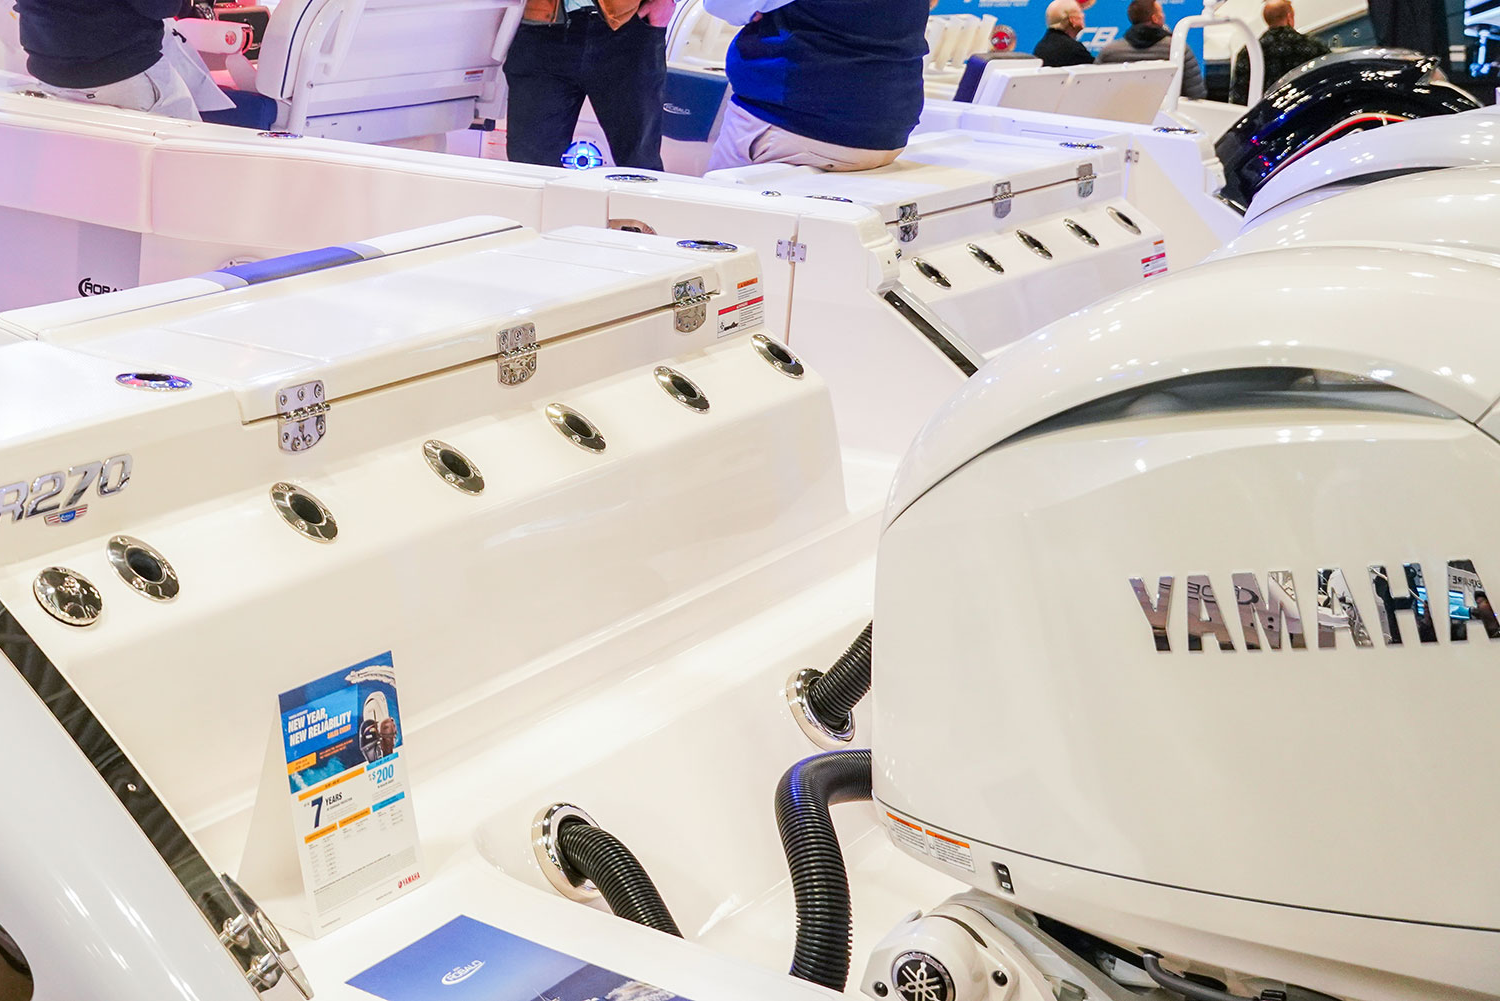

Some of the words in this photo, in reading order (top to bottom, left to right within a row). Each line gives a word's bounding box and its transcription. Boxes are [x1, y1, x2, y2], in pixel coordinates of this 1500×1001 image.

[1127, 559, 1500, 653] YAMAHA
[288, 713, 305, 734] NEW
[306, 707, 328, 726] YEAR,
[289, 731, 308, 748] NEW
[308, 710, 352, 740] RELIABILITY
[311, 795, 323, 829] 7
[325, 791, 343, 807] YEARS
